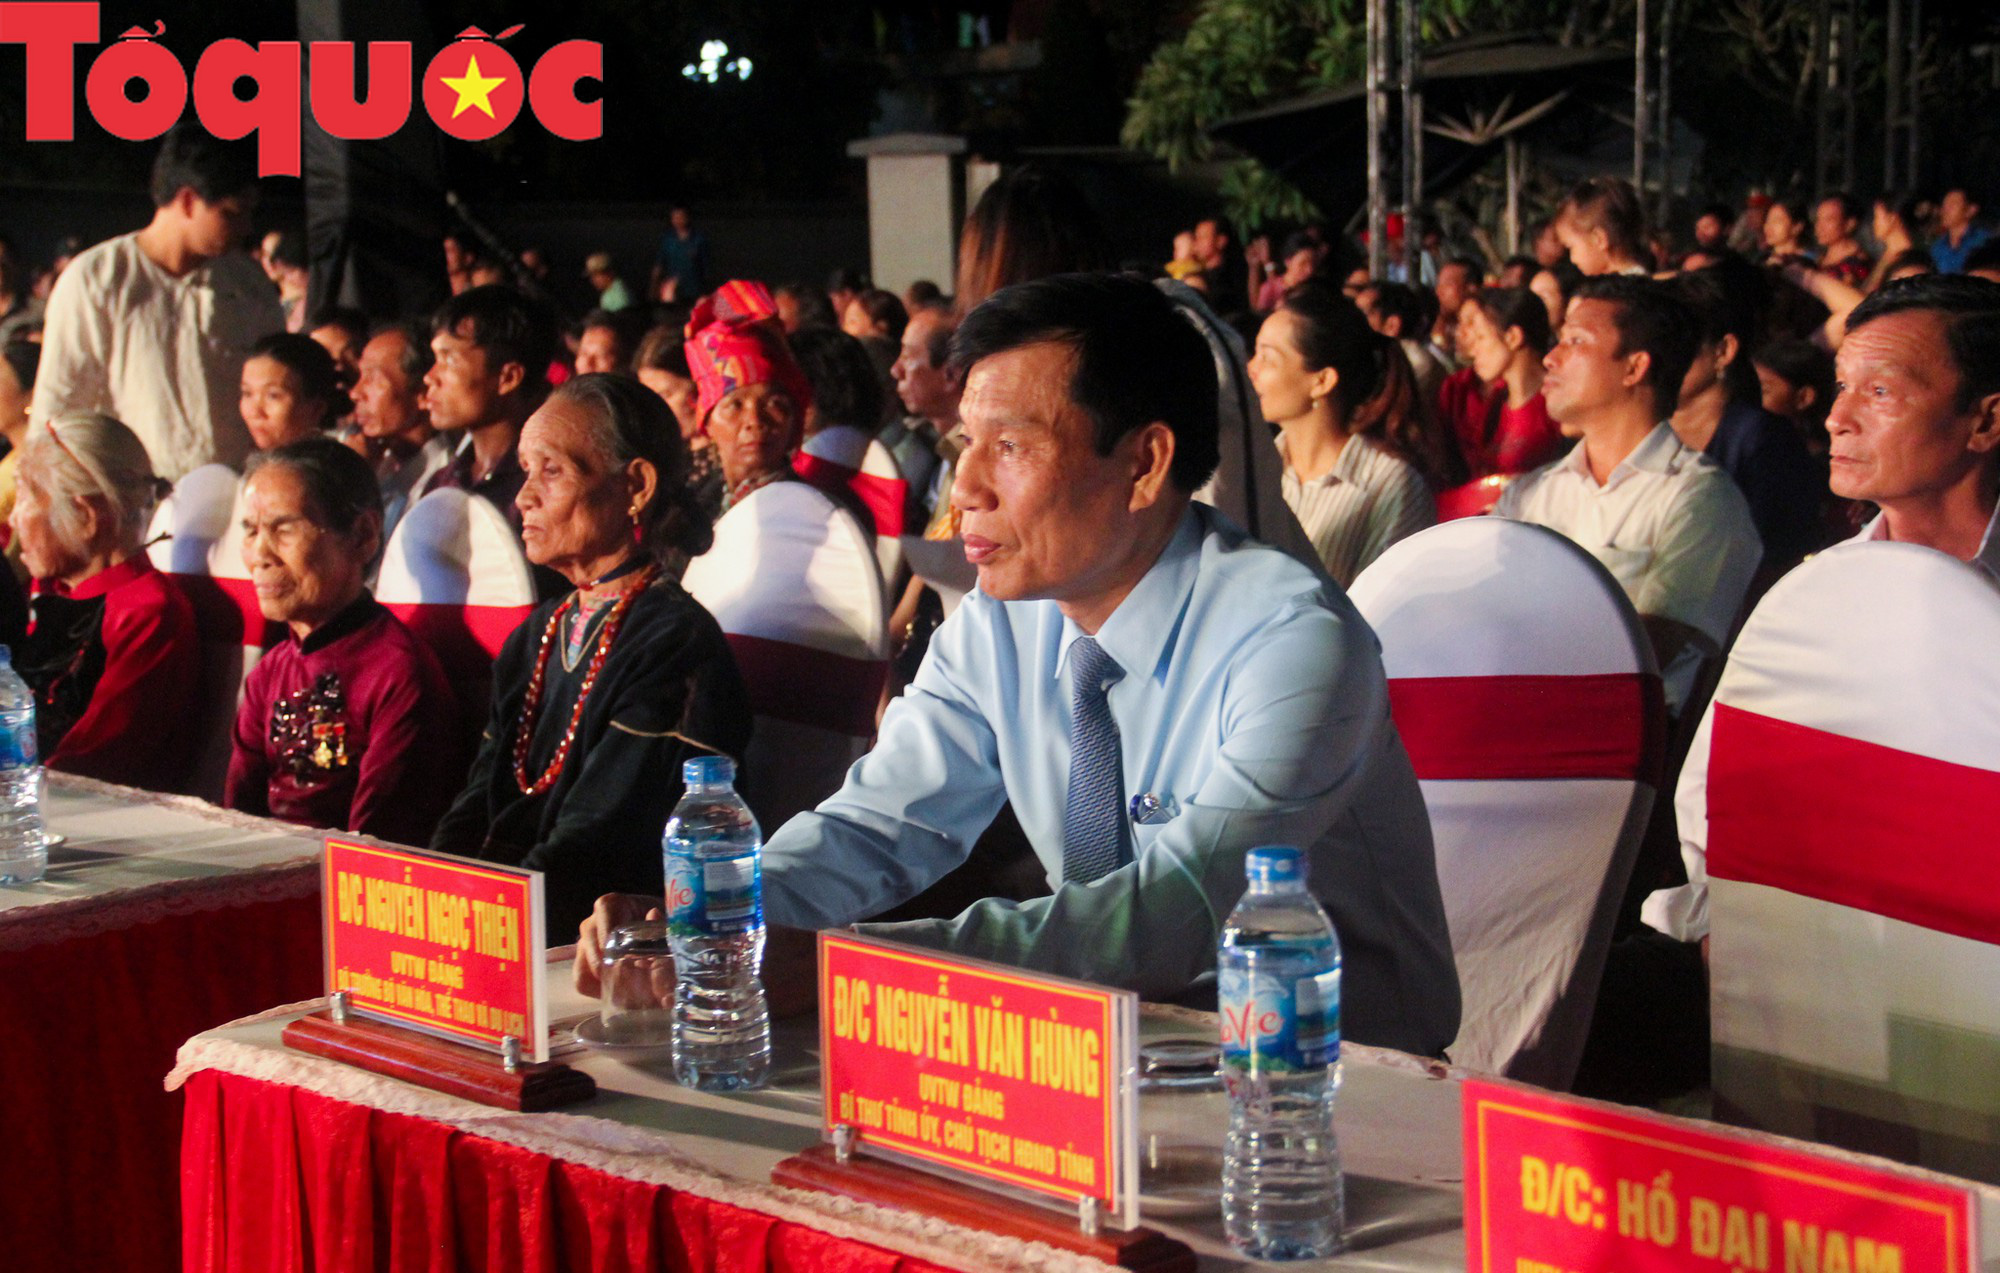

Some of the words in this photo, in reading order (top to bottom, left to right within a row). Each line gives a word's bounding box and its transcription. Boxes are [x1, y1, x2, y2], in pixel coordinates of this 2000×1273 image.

[337, 871, 364, 926] Đ/C
[427, 889, 471, 960] NGỌC
[472, 893, 519, 972] THIỆN
[833, 975, 871, 1043] Đ/C
[876, 974, 969, 1066] NGUYỄN
[974, 995, 1024, 1080] VĂN
[1030, 1006, 1100, 1098] HÙNG
[963, 1077, 1004, 1120] ĐẢNG
[1520, 1154, 1606, 1231] Đ/C:
